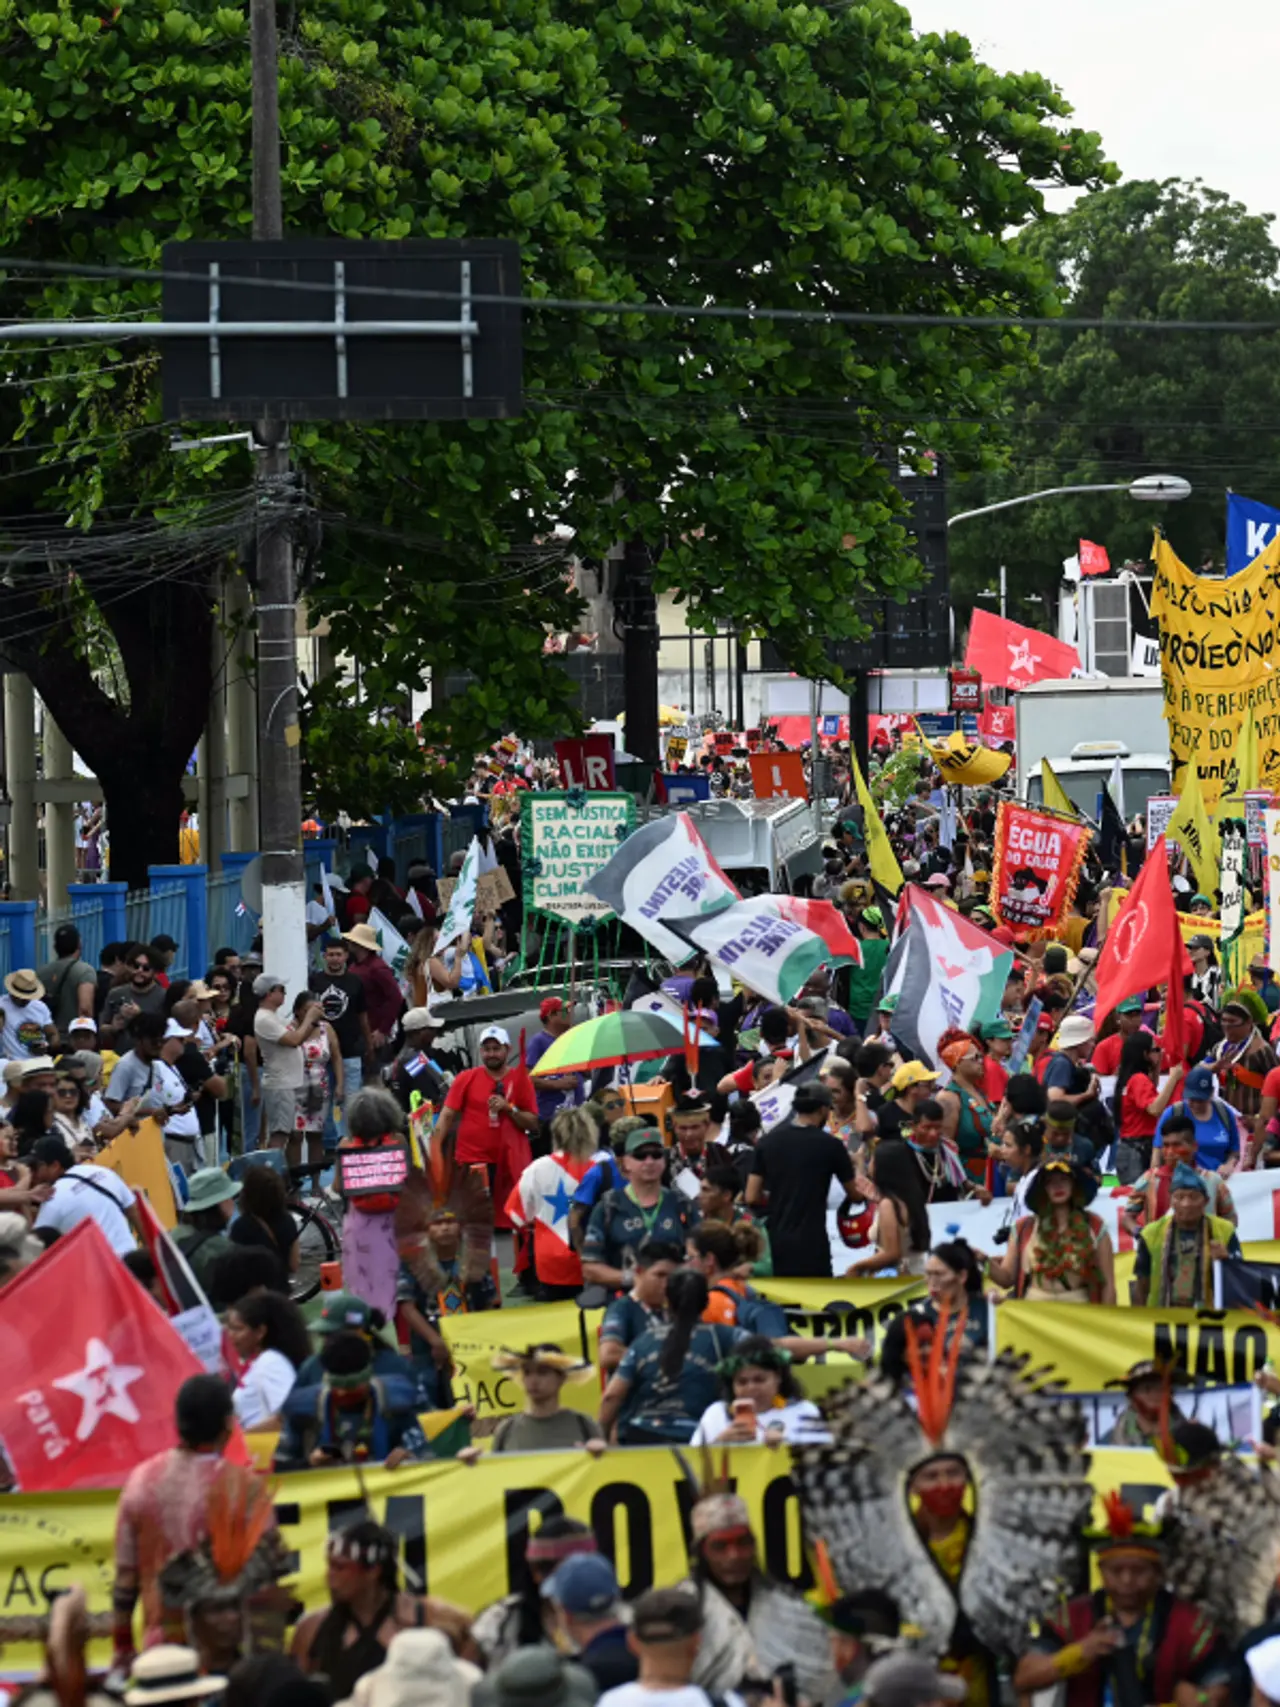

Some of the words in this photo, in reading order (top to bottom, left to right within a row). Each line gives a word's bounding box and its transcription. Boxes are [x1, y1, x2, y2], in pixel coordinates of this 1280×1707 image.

[1209, 728, 1233, 751] DO
[535, 806, 568, 821] SEM
[543, 824, 614, 840] RACIAL
[1008, 819, 1061, 857] ÉGUA
[536, 841, 572, 859] NÃO
[16, 1389, 72, 1461] Pará
[506, 1475, 817, 1608] POO
